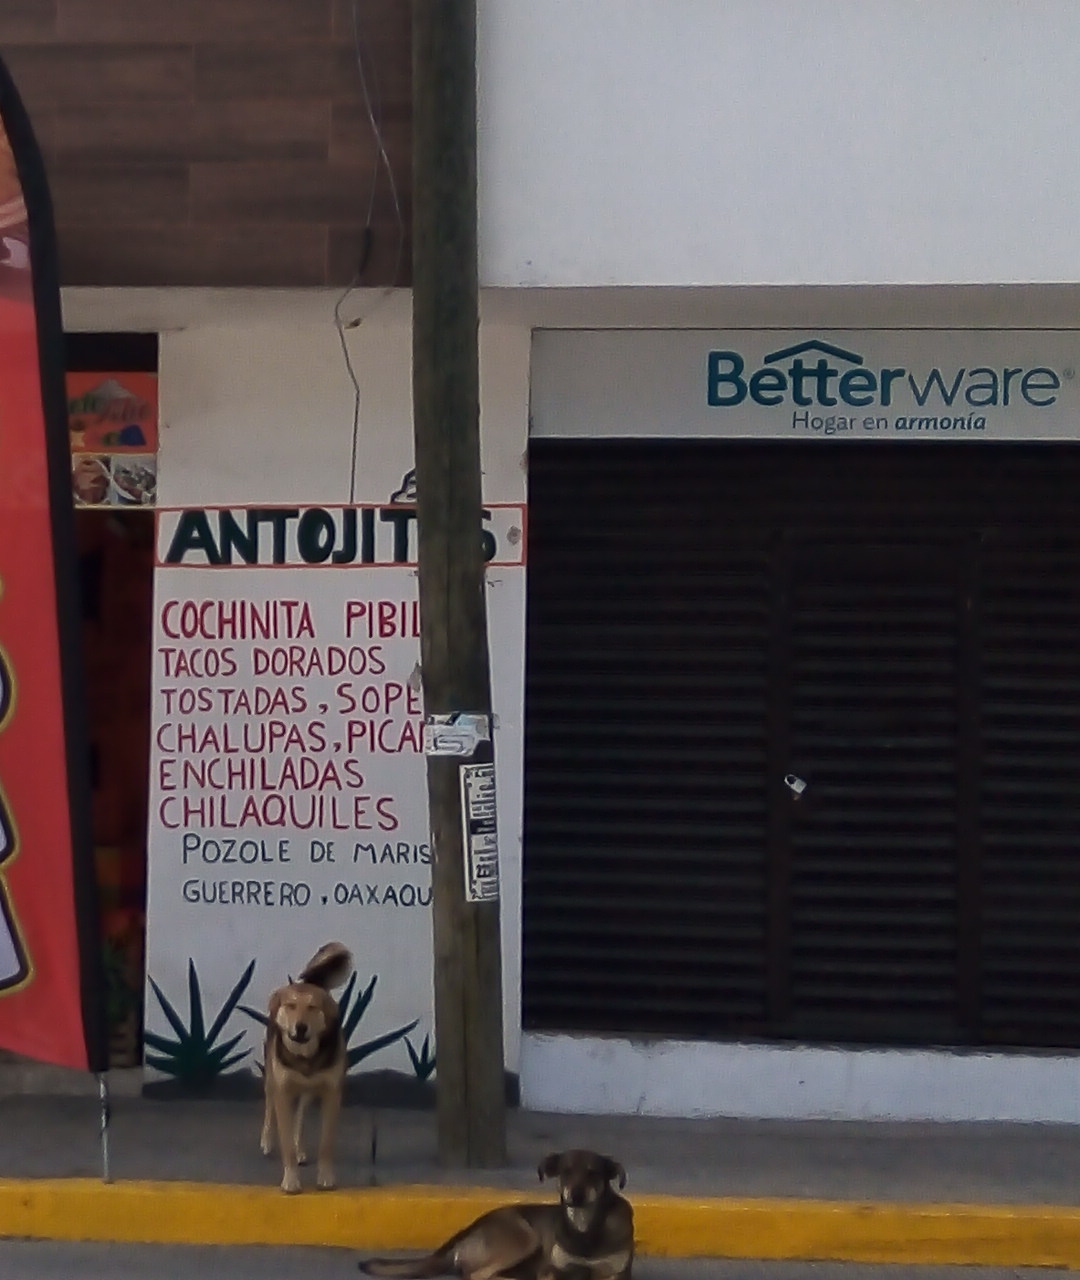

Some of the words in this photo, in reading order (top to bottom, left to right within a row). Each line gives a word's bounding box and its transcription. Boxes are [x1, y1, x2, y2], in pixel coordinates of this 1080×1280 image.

[706, 340, 1061, 408] Betterware
[792, 411, 855, 434] Hogar
[863, 416, 889, 431] en
[894, 412, 987, 431] armonía
[162, 600, 316, 640] COCHINITA
[346, 600, 421, 639] PIBIL
[158, 647, 238, 678] TACOS
[253, 645, 386, 677] DORADOS
[337, 683, 422, 715] SOPE
[160, 757, 364, 791] ENCHILADAS
[160, 794, 399, 831] CHILAQUILES
[311, 841, 336, 863] DE
[354, 842, 432, 865] MARIS
[334, 882, 432, 908] OAXAQU
